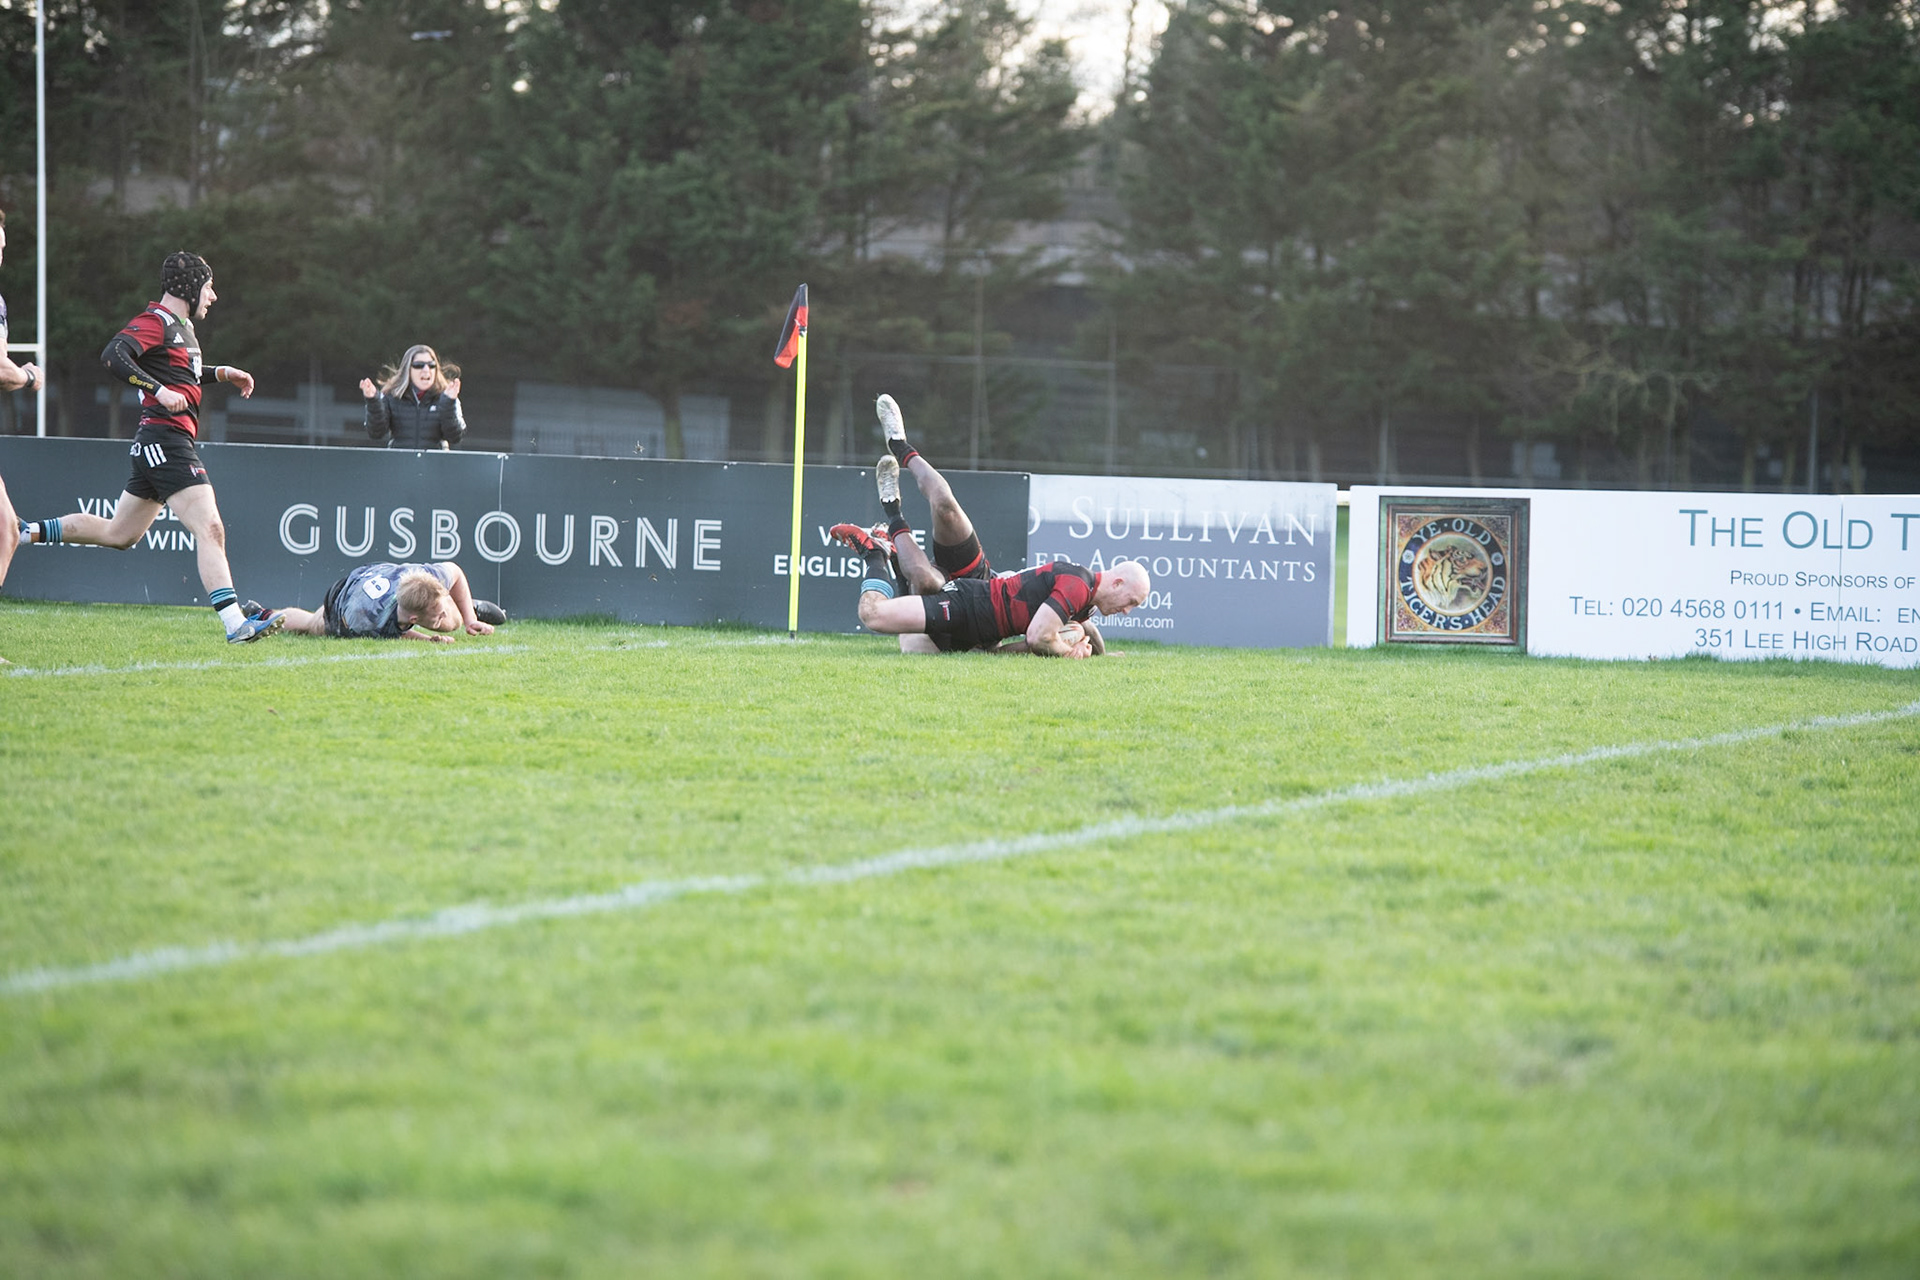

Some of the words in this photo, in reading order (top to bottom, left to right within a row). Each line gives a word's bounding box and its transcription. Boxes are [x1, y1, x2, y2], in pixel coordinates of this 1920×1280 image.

[1069, 496, 1317, 546] SULLIVAN
[1412, 522, 1441, 542] YE
[1452, 518, 1492, 545] OLD
[1679, 509, 1764, 548] THE
[1782, 510, 1873, 550] OLD
[145, 530, 195, 551] WIN
[279, 503, 723, 571] GUSBOURNE
[1730, 570, 1789, 586] PROUD
[1795, 571, 1888, 589] SPONSORS
[1894, 576, 1916, 589] OF
[1469, 576, 1505, 625] HEAD
[1569, 596, 1613, 616] TEL:
[1622, 597, 1662, 617] 020
[1670, 599, 1725, 619] 4568
[1734, 600, 1783, 620] 0111
[1810, 602, 1881, 623] EMAIL:
[1089, 613, 1174, 629] sullivan.com
[1695, 628, 1733, 648] 351
[1744, 629, 1784, 649] LEE
[1793, 631, 1847, 651] HIGH
[1856, 632, 1918, 653] ROAD
